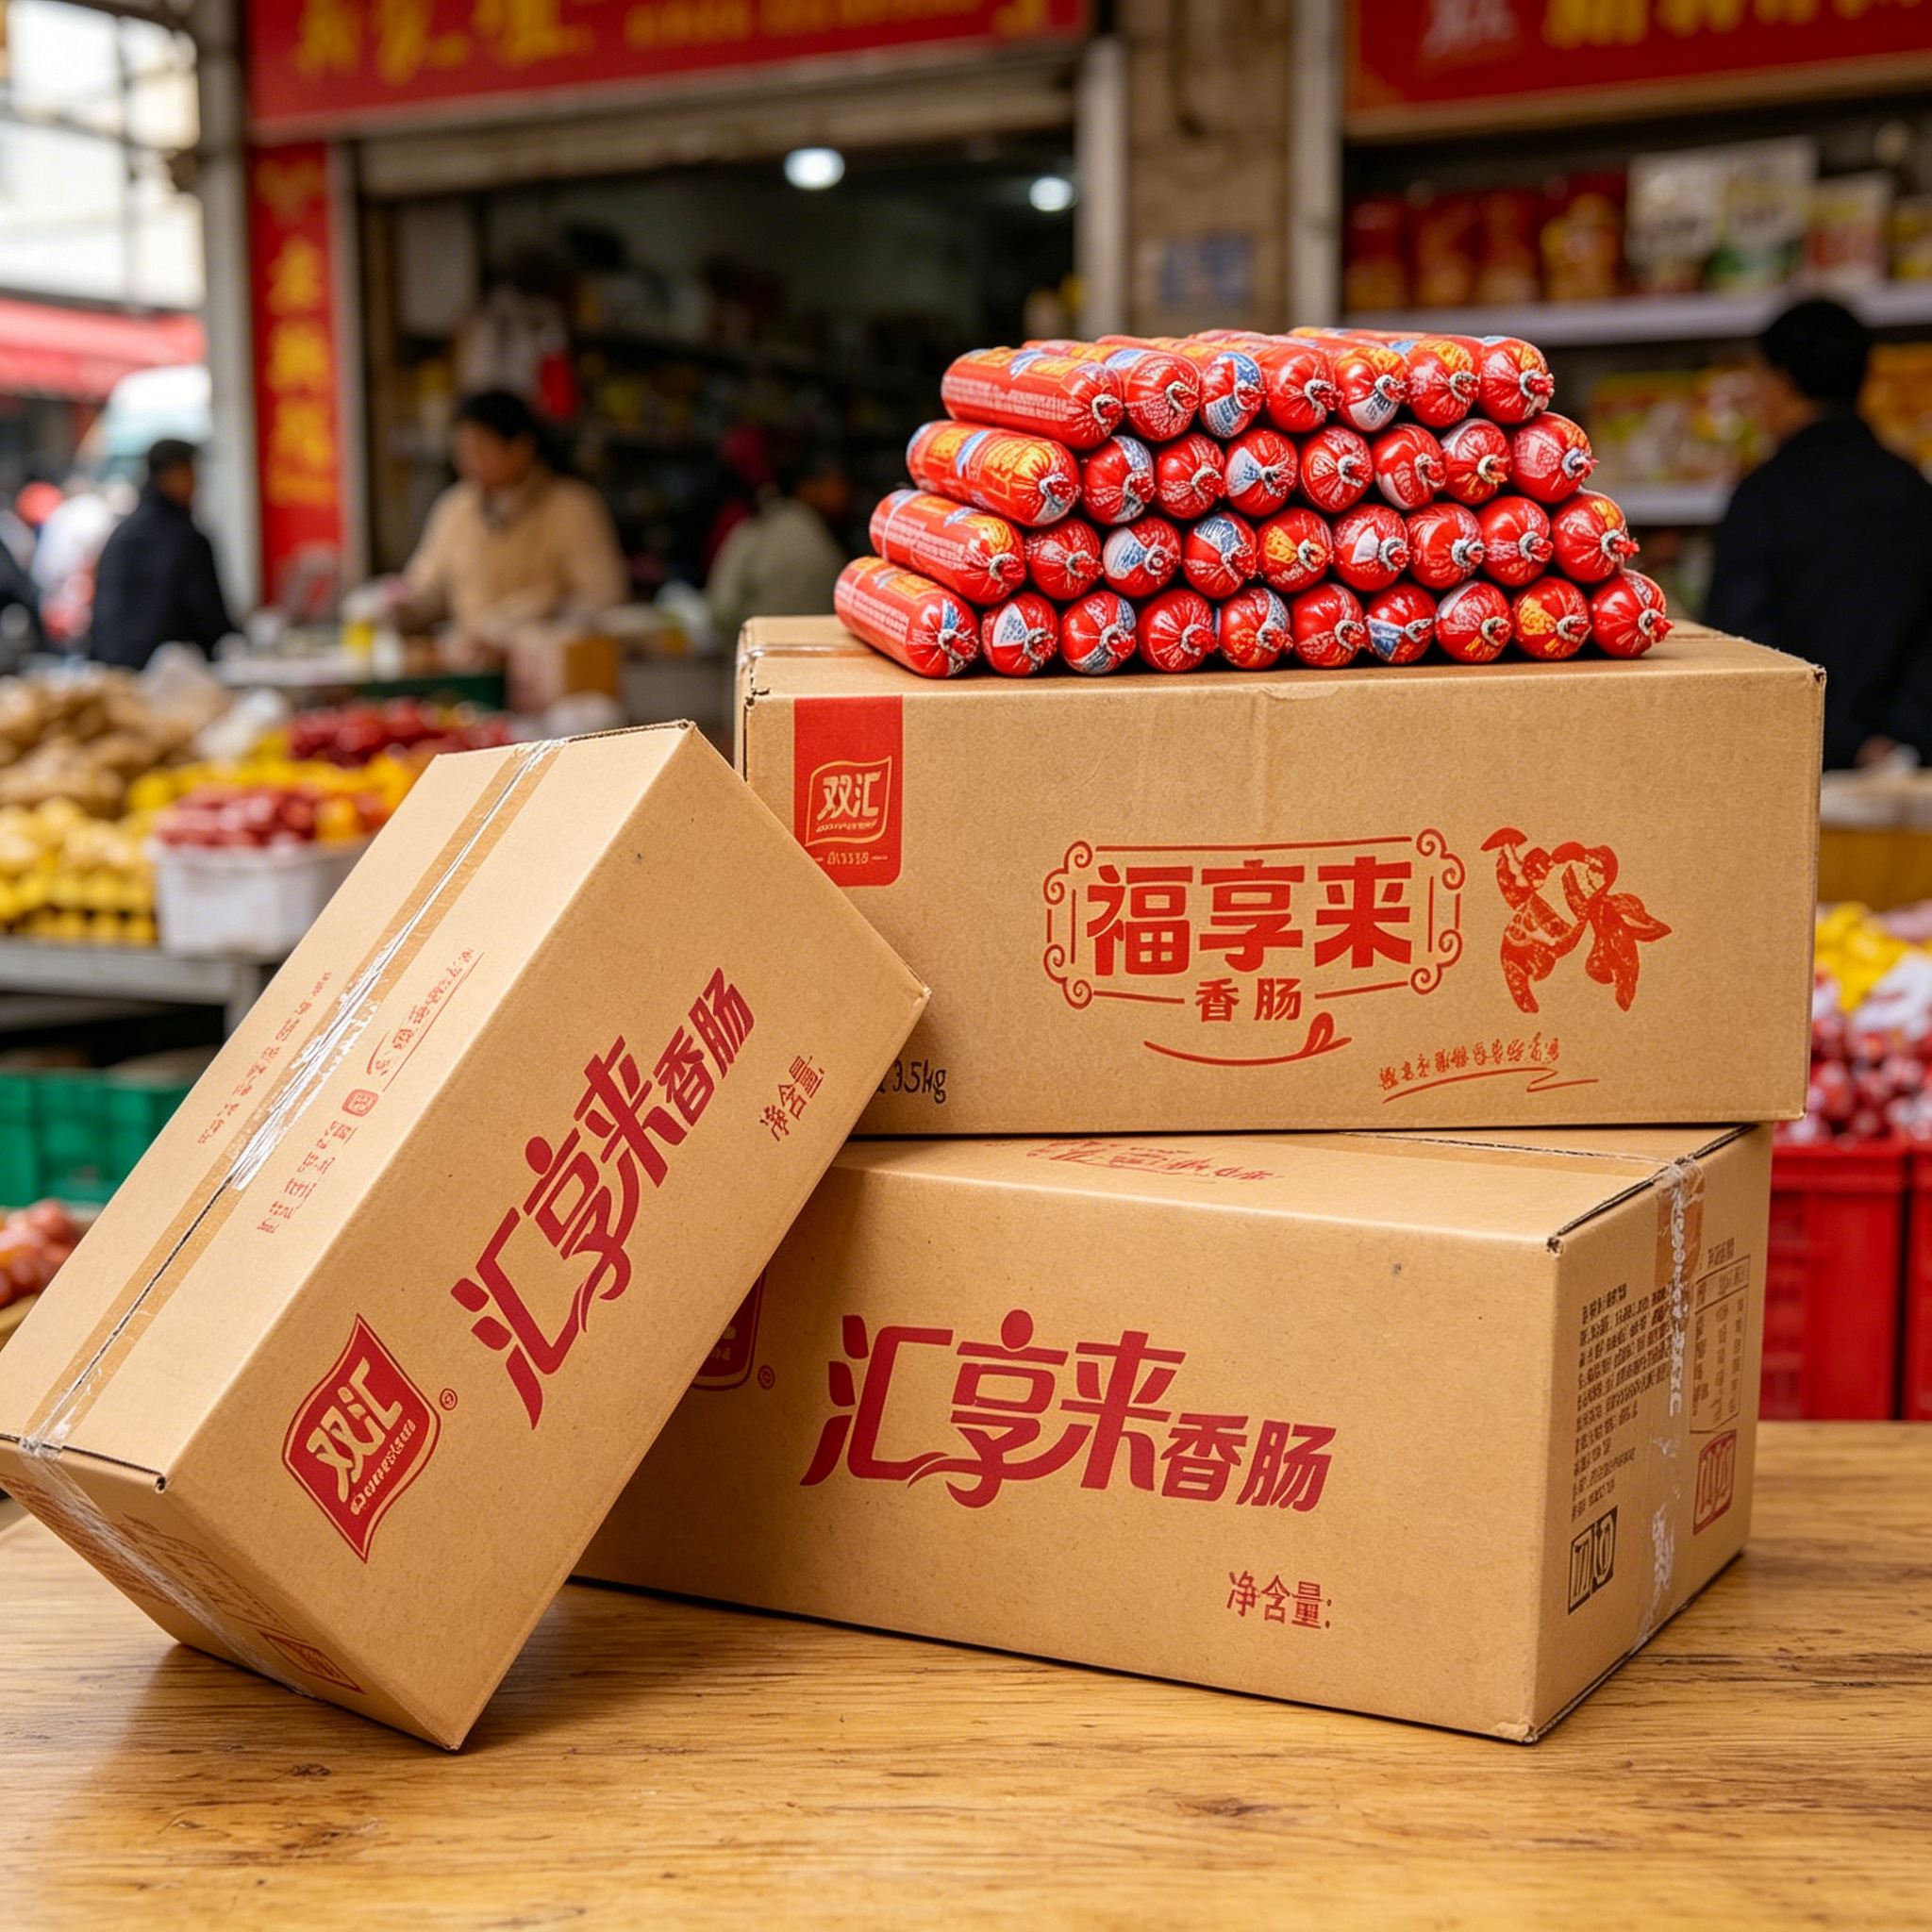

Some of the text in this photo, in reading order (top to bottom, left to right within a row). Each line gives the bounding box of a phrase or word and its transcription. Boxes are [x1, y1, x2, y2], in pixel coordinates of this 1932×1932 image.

[817, 772, 881, 821] 双汇
[1087, 856, 1412, 975] 福享来
[1195, 977, 1301, 1023] 香肠
[306, 1357, 403, 1503] 双汇
